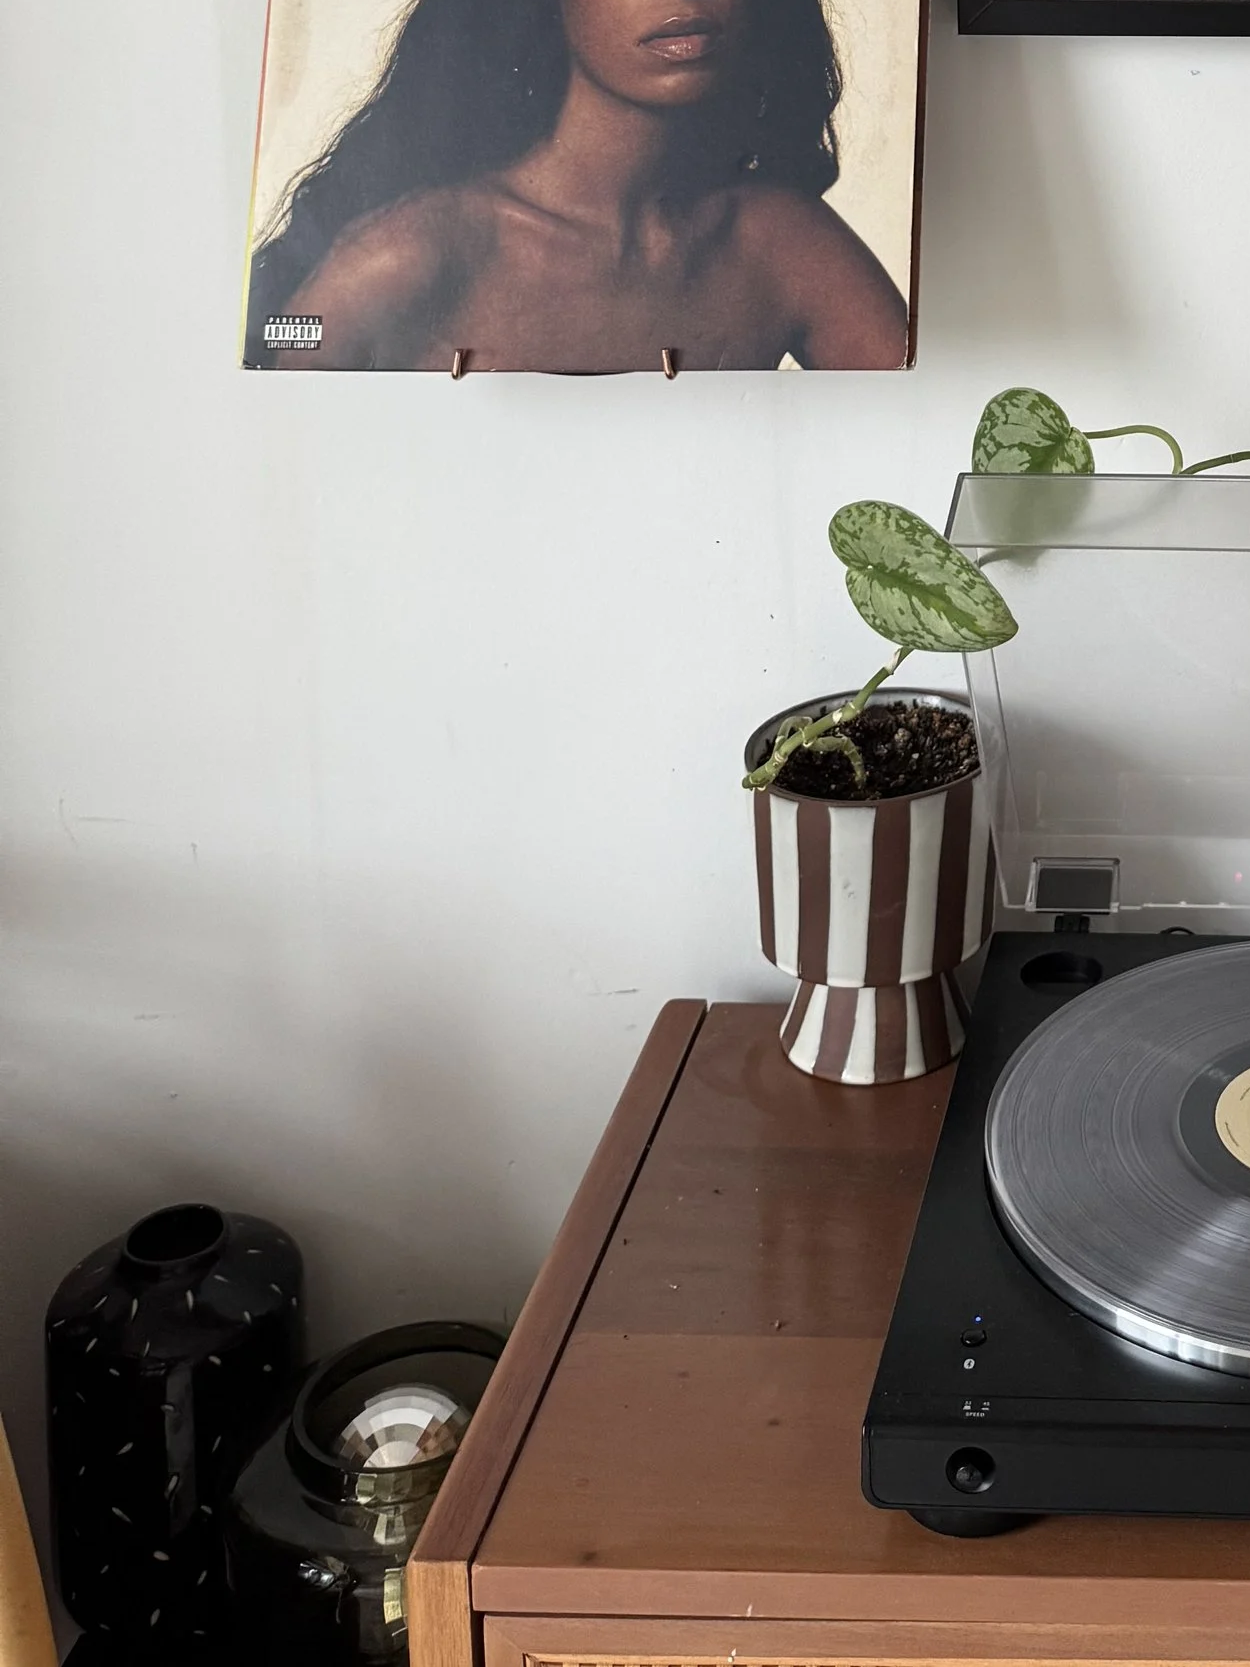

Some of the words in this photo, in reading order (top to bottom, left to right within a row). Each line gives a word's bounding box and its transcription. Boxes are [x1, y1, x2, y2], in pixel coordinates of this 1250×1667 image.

[267, 326, 320, 339] ADVISORY
[267, 341, 292, 349] EXPLICIT
[293, 341, 318, 349] CONTENT
